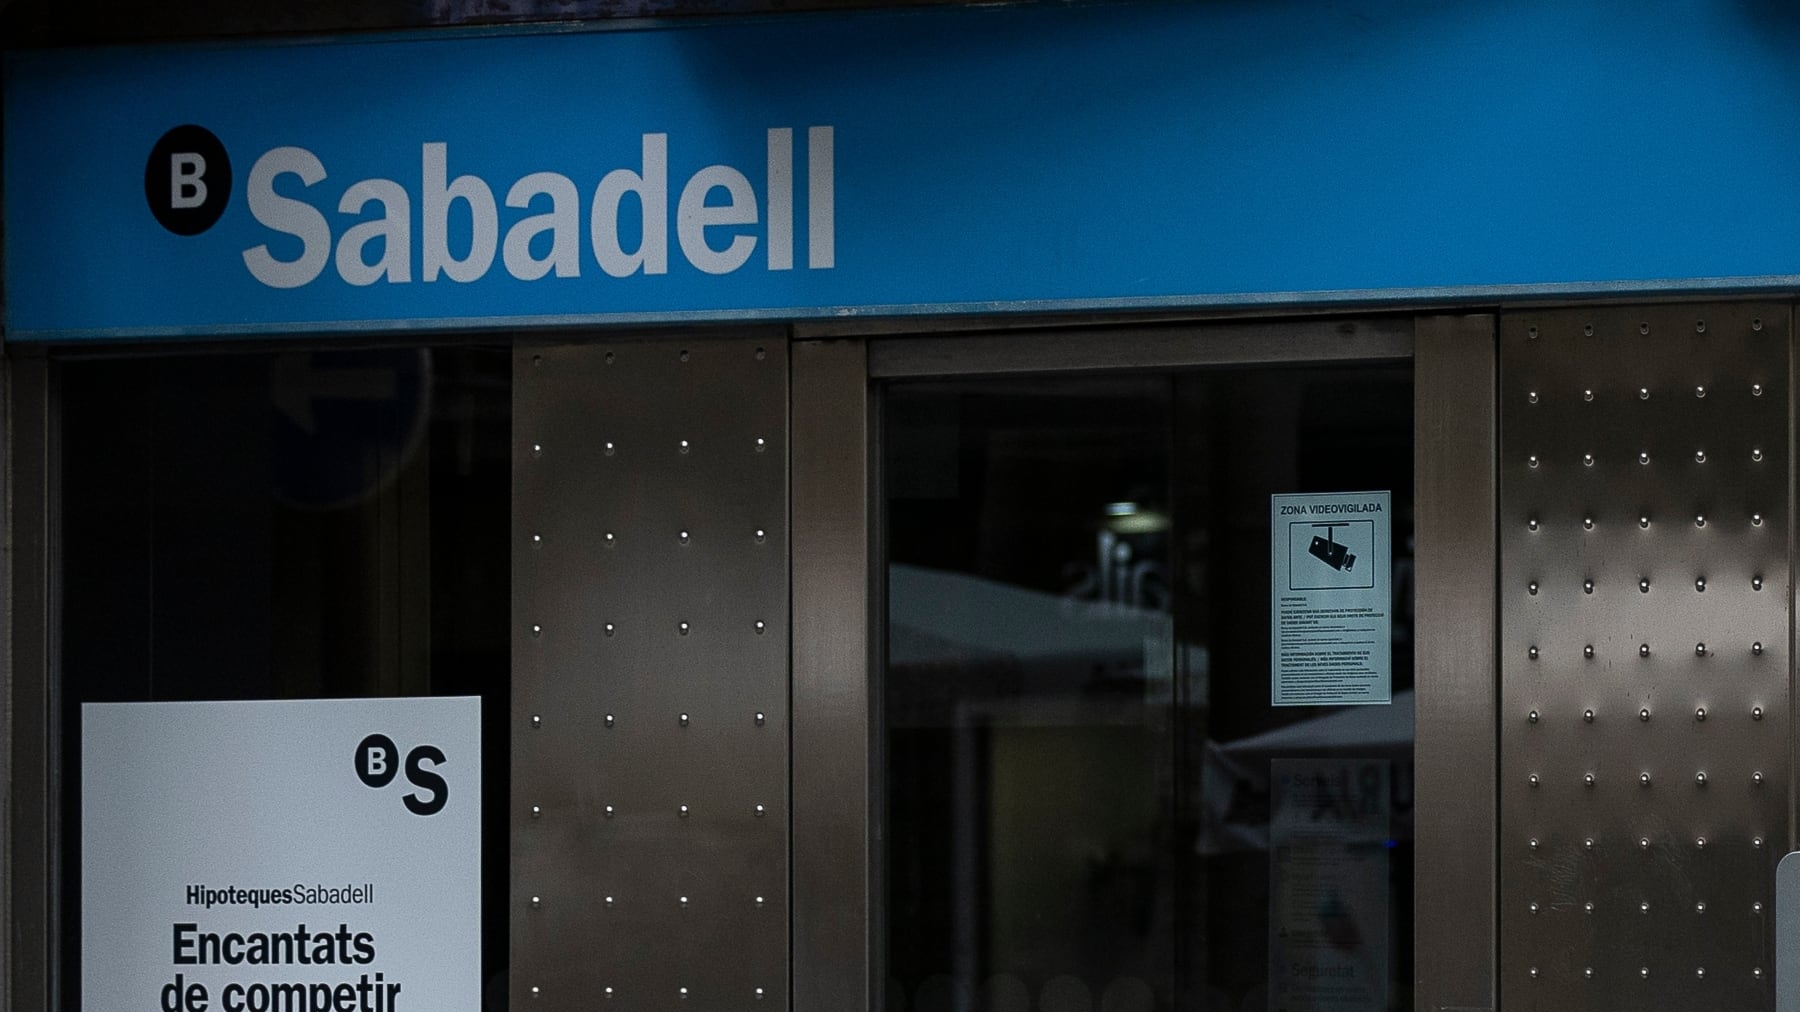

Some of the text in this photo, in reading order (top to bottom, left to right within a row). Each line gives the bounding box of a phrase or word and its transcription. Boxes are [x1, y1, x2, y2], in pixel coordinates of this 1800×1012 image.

[242, 126, 835, 289] Sabadell
[1281, 503, 1382, 515] ZONA VIDEOVIGILADA
[402, 745, 449, 816] S
[186, 883, 374, 909] HipotequesSabadell
[172, 923, 375, 965] Encantats
